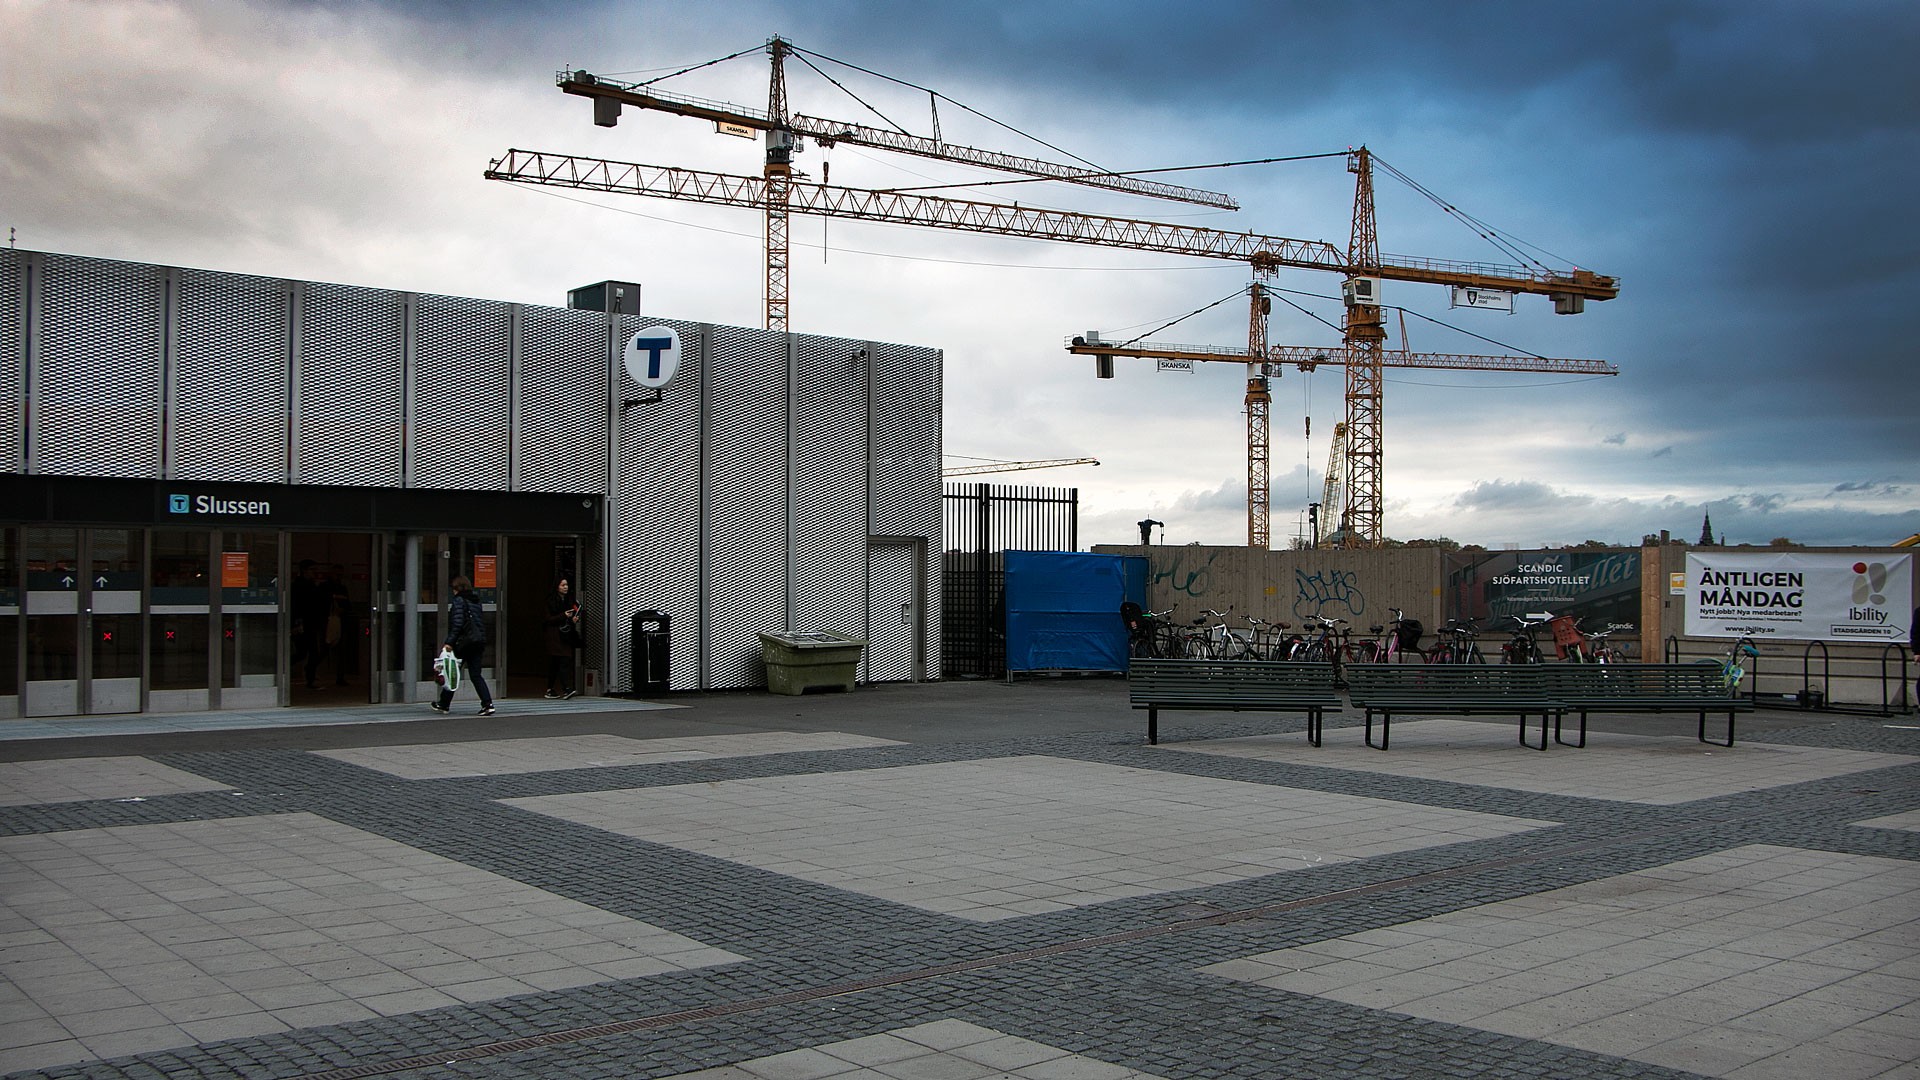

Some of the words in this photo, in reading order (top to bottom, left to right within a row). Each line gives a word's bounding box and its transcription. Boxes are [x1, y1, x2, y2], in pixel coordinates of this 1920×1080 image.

[637, 337, 672, 378] T
[196, 495, 270, 514] Slussen
[1518, 564, 1563, 573] SCANDIC
[1492, 574, 1590, 585] SJÖFARTSHOTELLET
[1699, 567, 1803, 587] ÄNTLIGEN
[1700, 587, 1803, 608] MÅNDAG
[1700, 609, 1715, 617] Nytt
[1849, 607, 1888, 624] Ibility
[1607, 622, 1634, 631] Scandic
[1725, 625, 1775, 633] www.ibility.se
